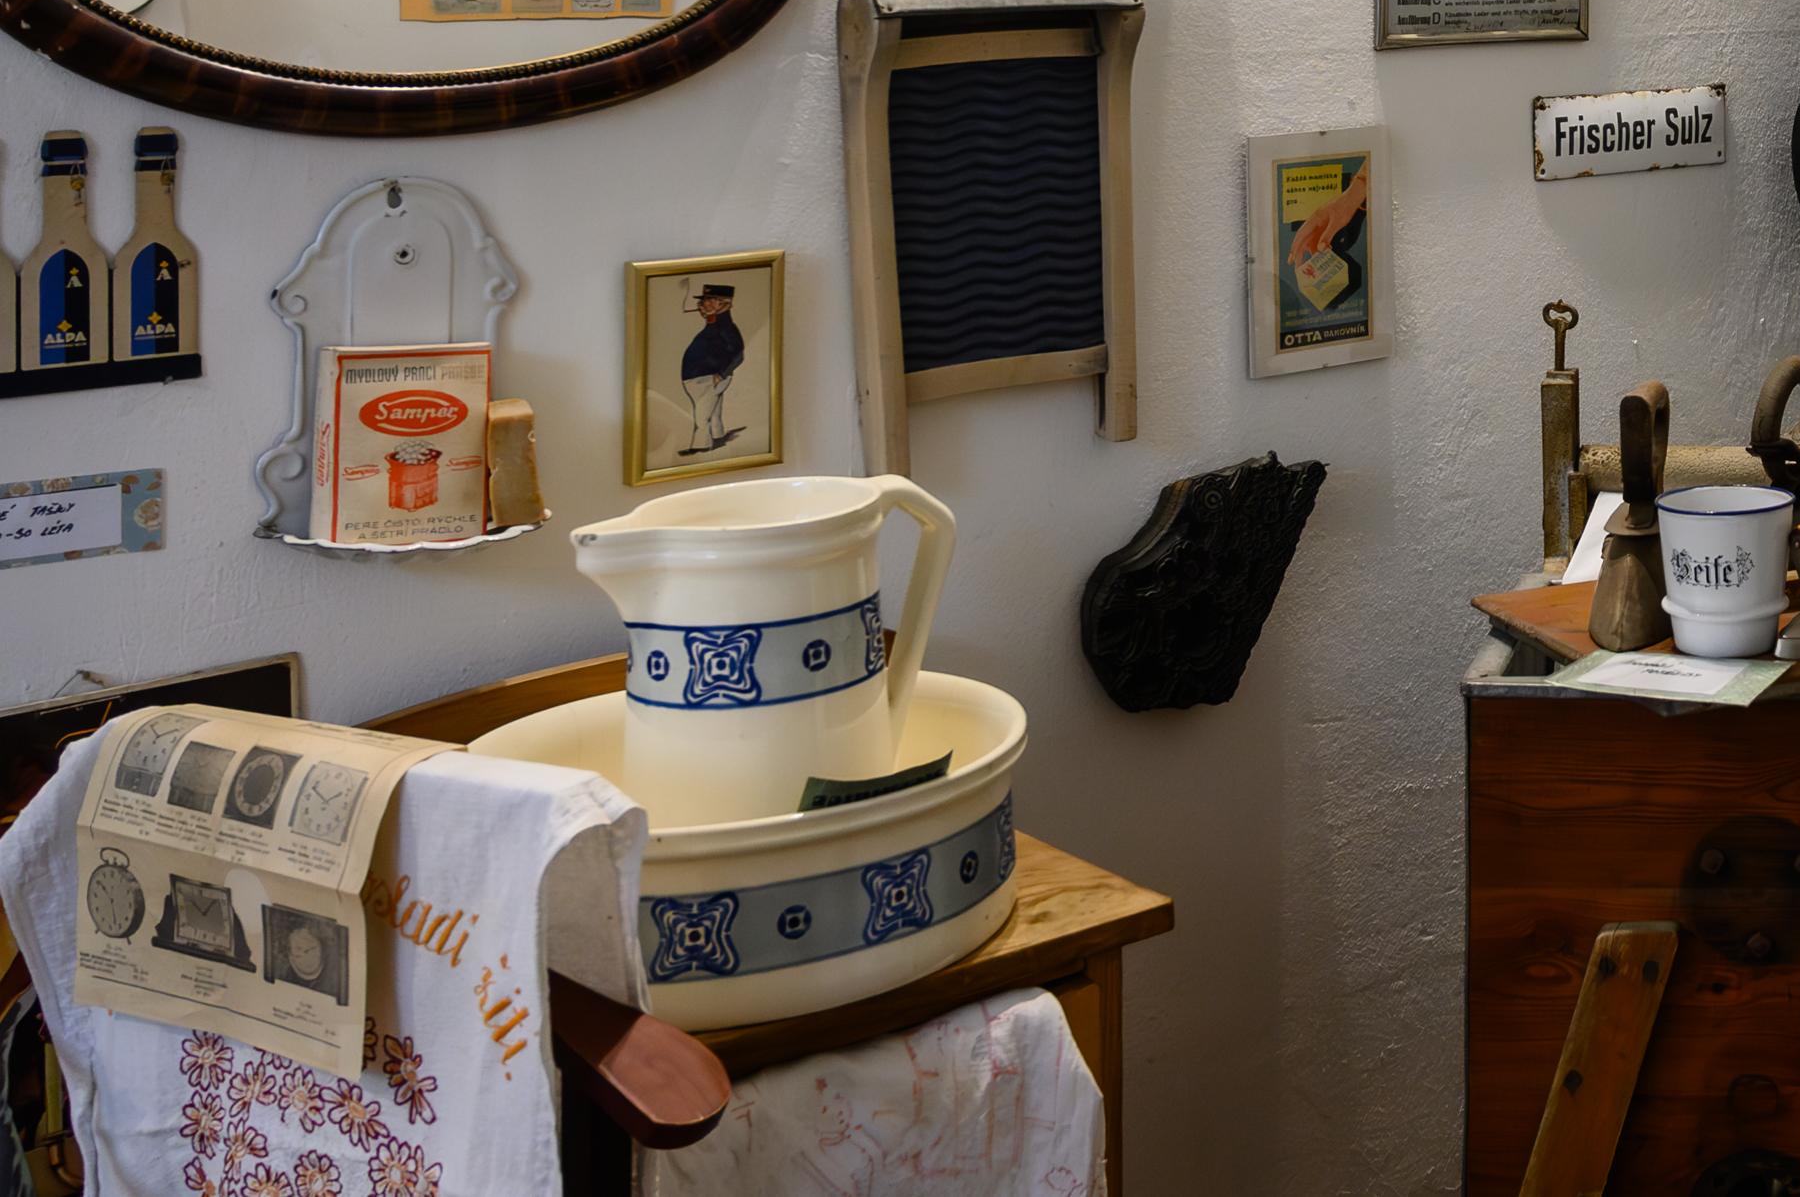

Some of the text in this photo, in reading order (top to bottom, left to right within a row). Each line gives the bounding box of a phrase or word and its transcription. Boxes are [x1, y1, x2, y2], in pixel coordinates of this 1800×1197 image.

[1432, 11, 1441, 25] D
[1555, 105, 1714, 157] Frischer Sulz
[134, 322, 176, 336] ALPA
[43, 331, 87, 345] ALPA
[1284, 330, 1323, 346] OTTA
[375, 401, 459, 424] Samper
[40, 519, 74, 537] LÉTA
[1671, 548, 1734, 590] Seife
